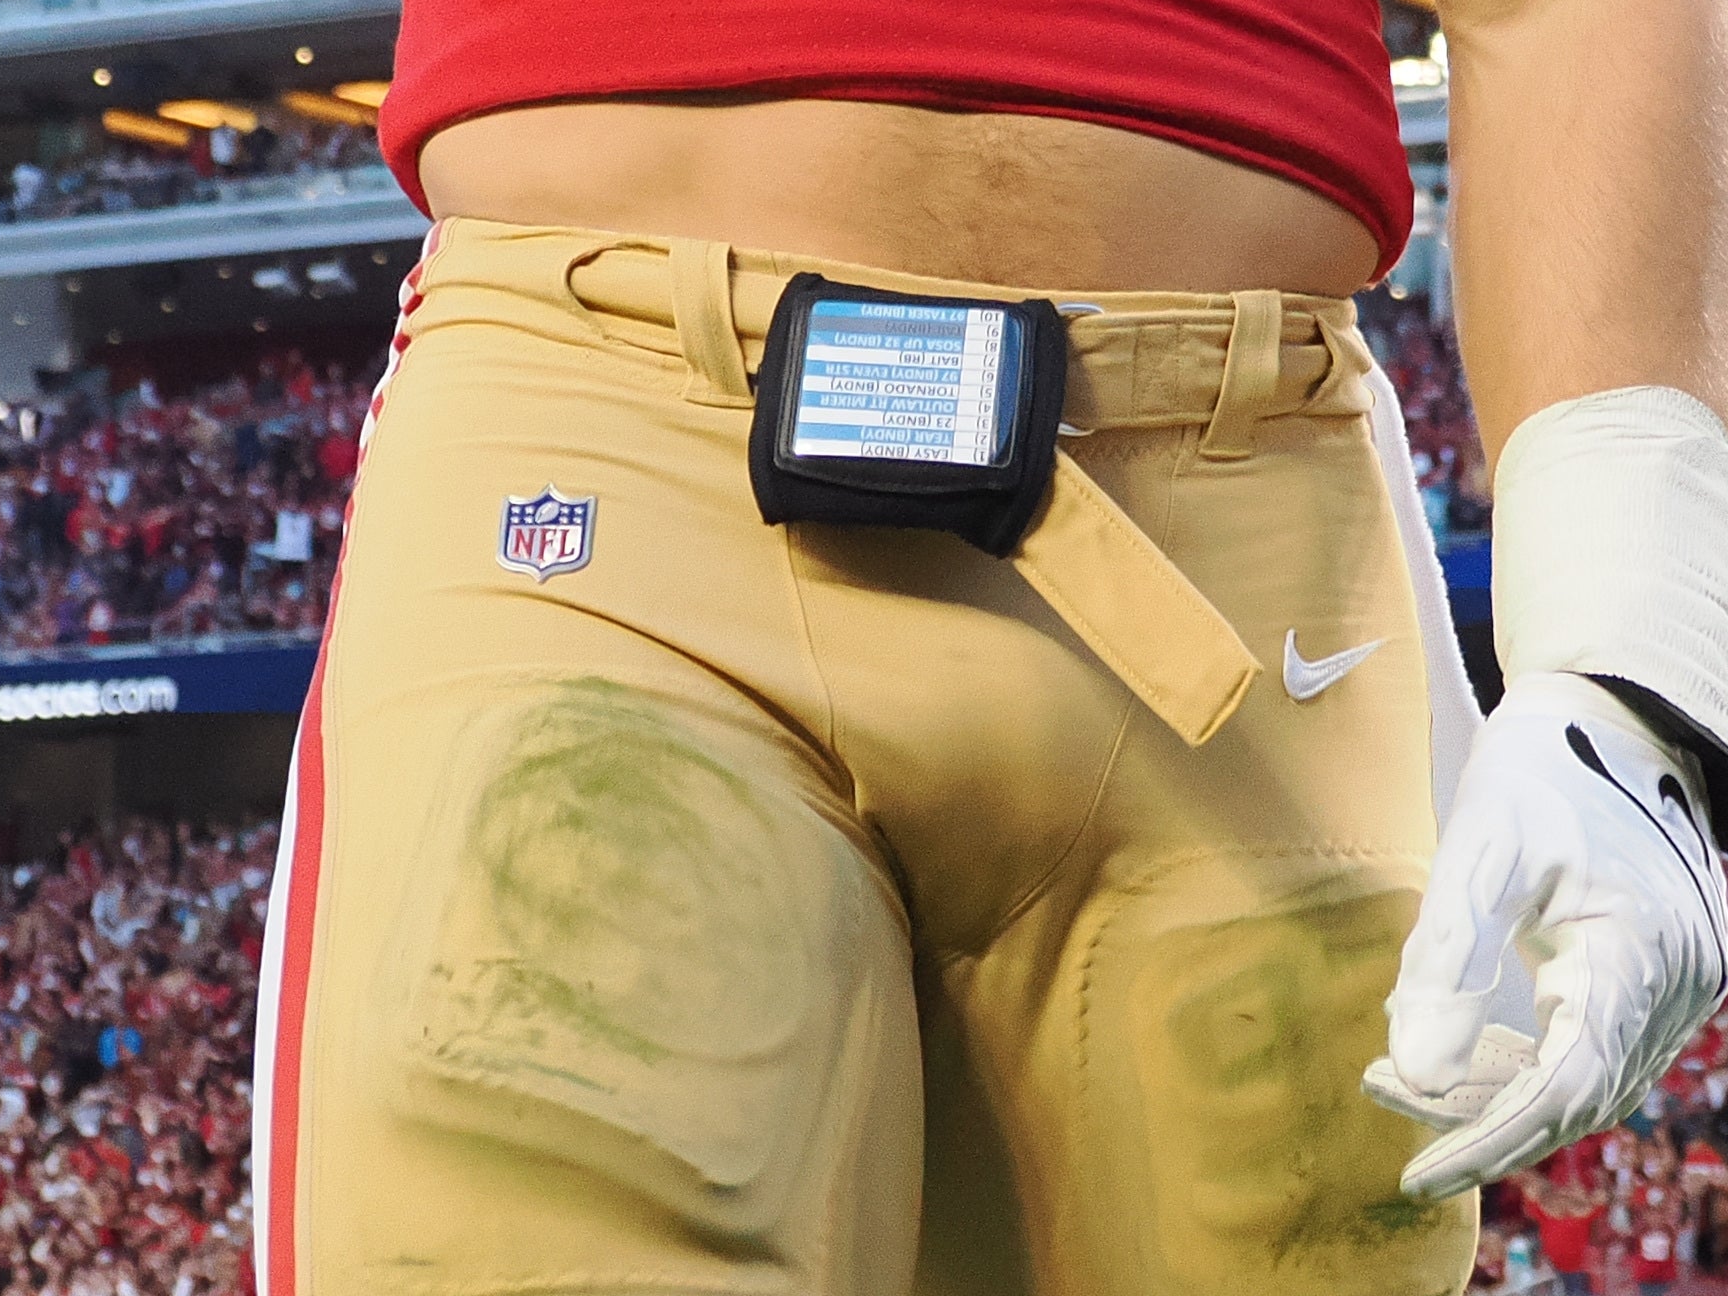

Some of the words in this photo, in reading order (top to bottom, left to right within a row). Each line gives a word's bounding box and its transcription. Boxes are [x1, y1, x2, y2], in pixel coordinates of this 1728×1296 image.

[861, 304, 905, 319] (BNDY)
[909, 308, 946, 320] TASER
[950, 310, 965, 320] 97
[980, 310, 1000, 322] 10)
[986, 325, 999, 337] 9)
[834, 332, 881, 347] (BNDY)
[905, 337, 922, 349] UP
[928, 339, 961, 351] SOSA
[985, 340, 997, 352] 8)
[899, 351, 925, 365] (RB)
[931, 354, 959, 366] BAIT
[983, 355, 995, 367] 7)
[856, 364, 888, 377] EVEN
[891, 365, 938, 380] (BNDY)
[942, 369, 958, 381] 97
[982, 370, 994, 382] 6)
[830, 378, 880, 393] (BNDY)
[884, 382, 955, 397] TORNADO
[980, 385, 992, 398] 5)
[820, 395, 866, 407] MIXER
[892, 399, 954, 413] OUTLAW
[978, 401, 991, 414] 4)
[882, 412, 931, 427] (BNDY)
[936, 416, 951, 428] 23
[976, 416, 989, 429] 3)
[860, 426, 912, 442] (BNDY)
[915, 431, 951, 443] TEAR
[975, 432, 987, 445] 2)
[860, 442, 910, 458] (BNDY)
[915, 447, 949, 460] EASY
[973, 447, 985, 460] 1)
[512, 527, 575, 561] NFL
